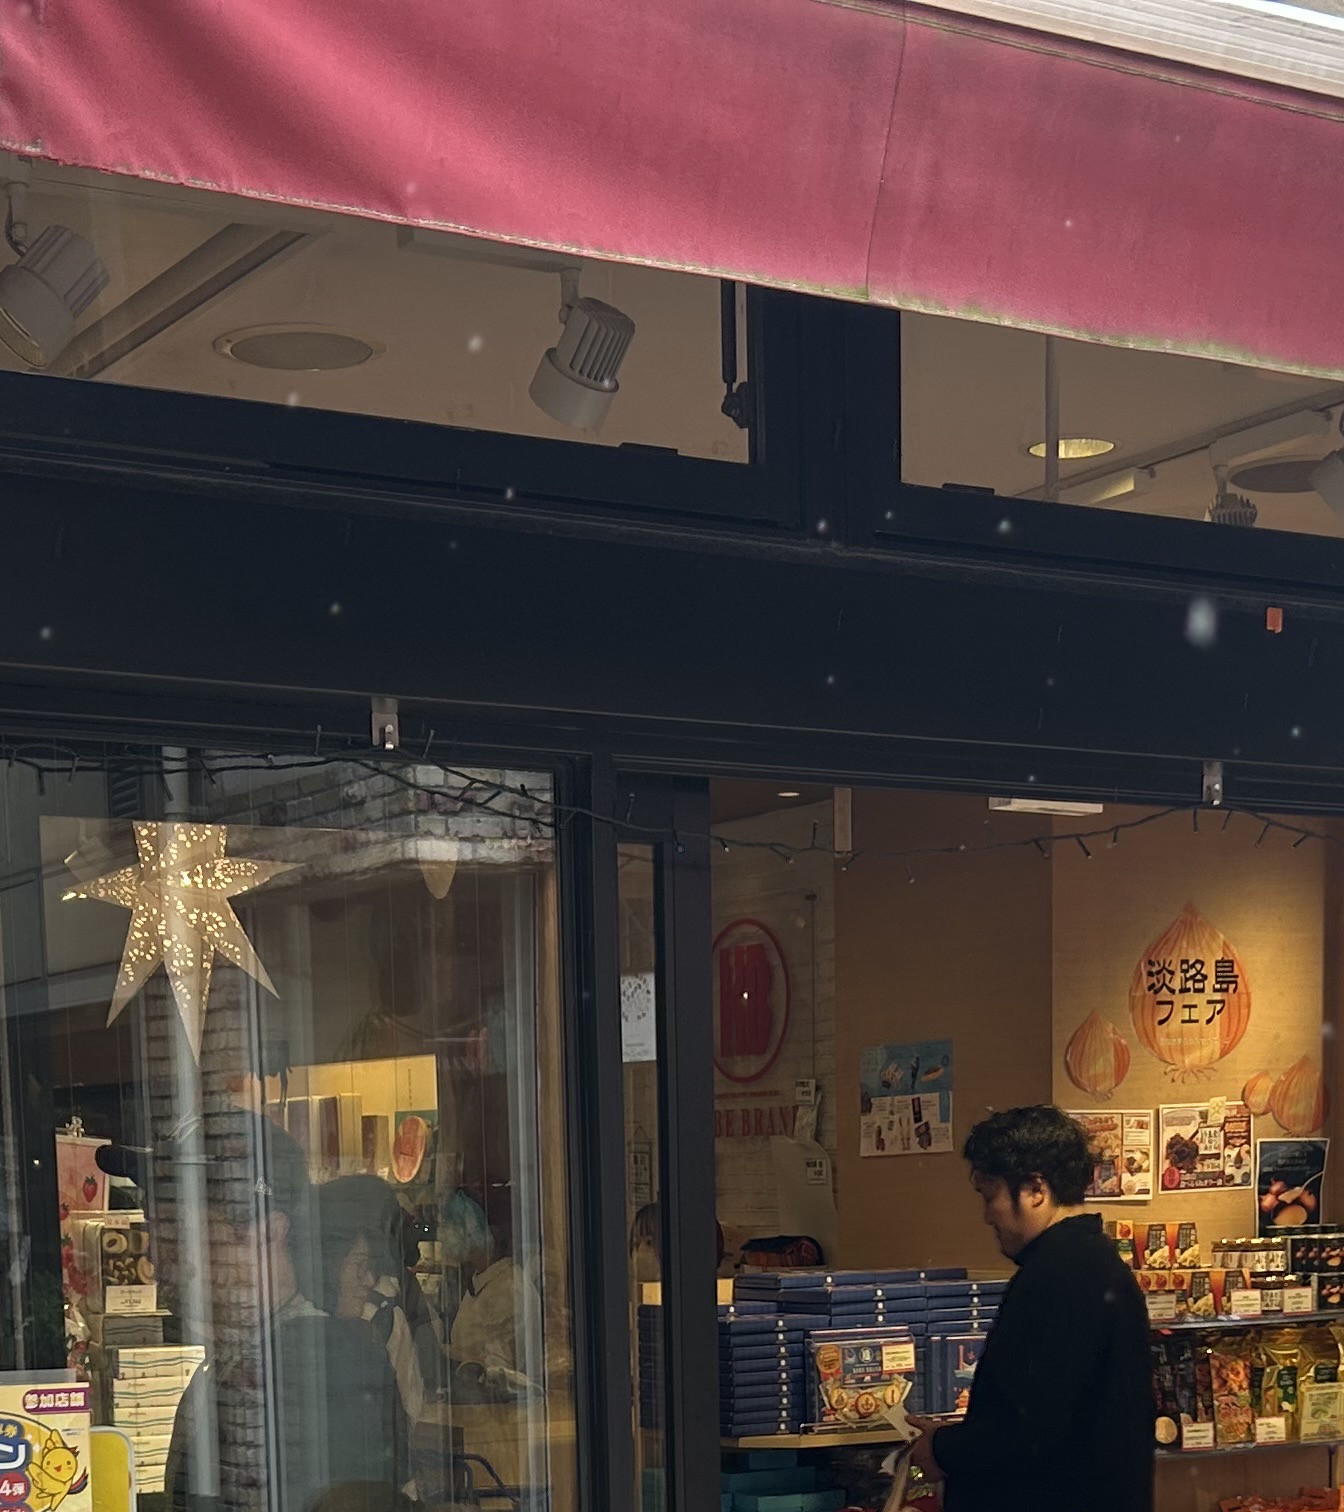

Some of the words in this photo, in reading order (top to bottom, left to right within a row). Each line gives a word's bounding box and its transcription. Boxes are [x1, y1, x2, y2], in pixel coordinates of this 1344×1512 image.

[1147, 957, 1239, 995] 淡路島
[1156, 1000, 1225, 1026] フェア
[25, 1392, 85, 1410] 参加店舗
